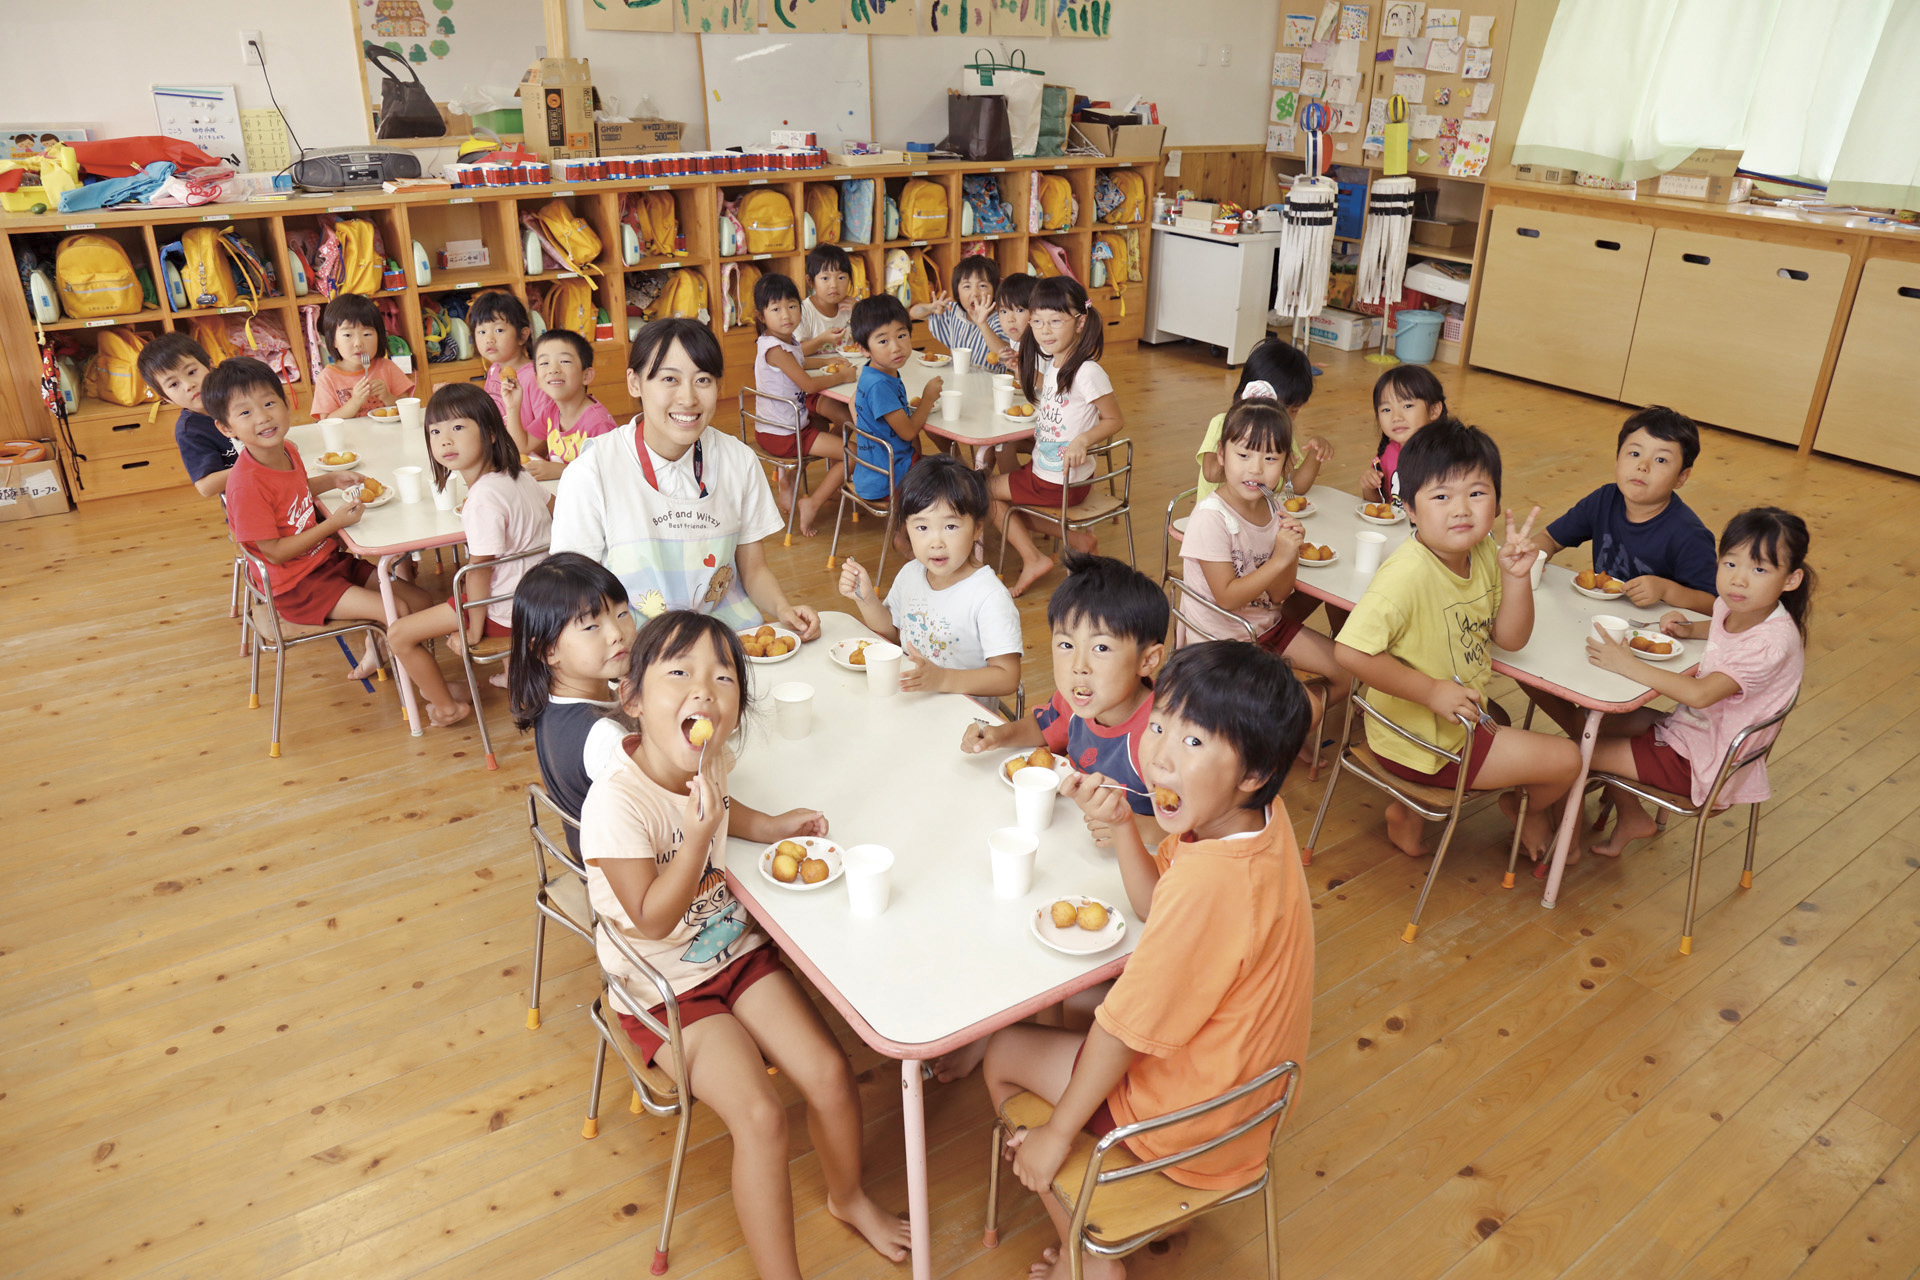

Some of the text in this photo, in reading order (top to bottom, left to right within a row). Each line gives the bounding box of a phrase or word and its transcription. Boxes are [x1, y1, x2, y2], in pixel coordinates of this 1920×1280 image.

[600, 125, 622, 133] GH591
[652, 510, 721, 528] Boof and Witzy
